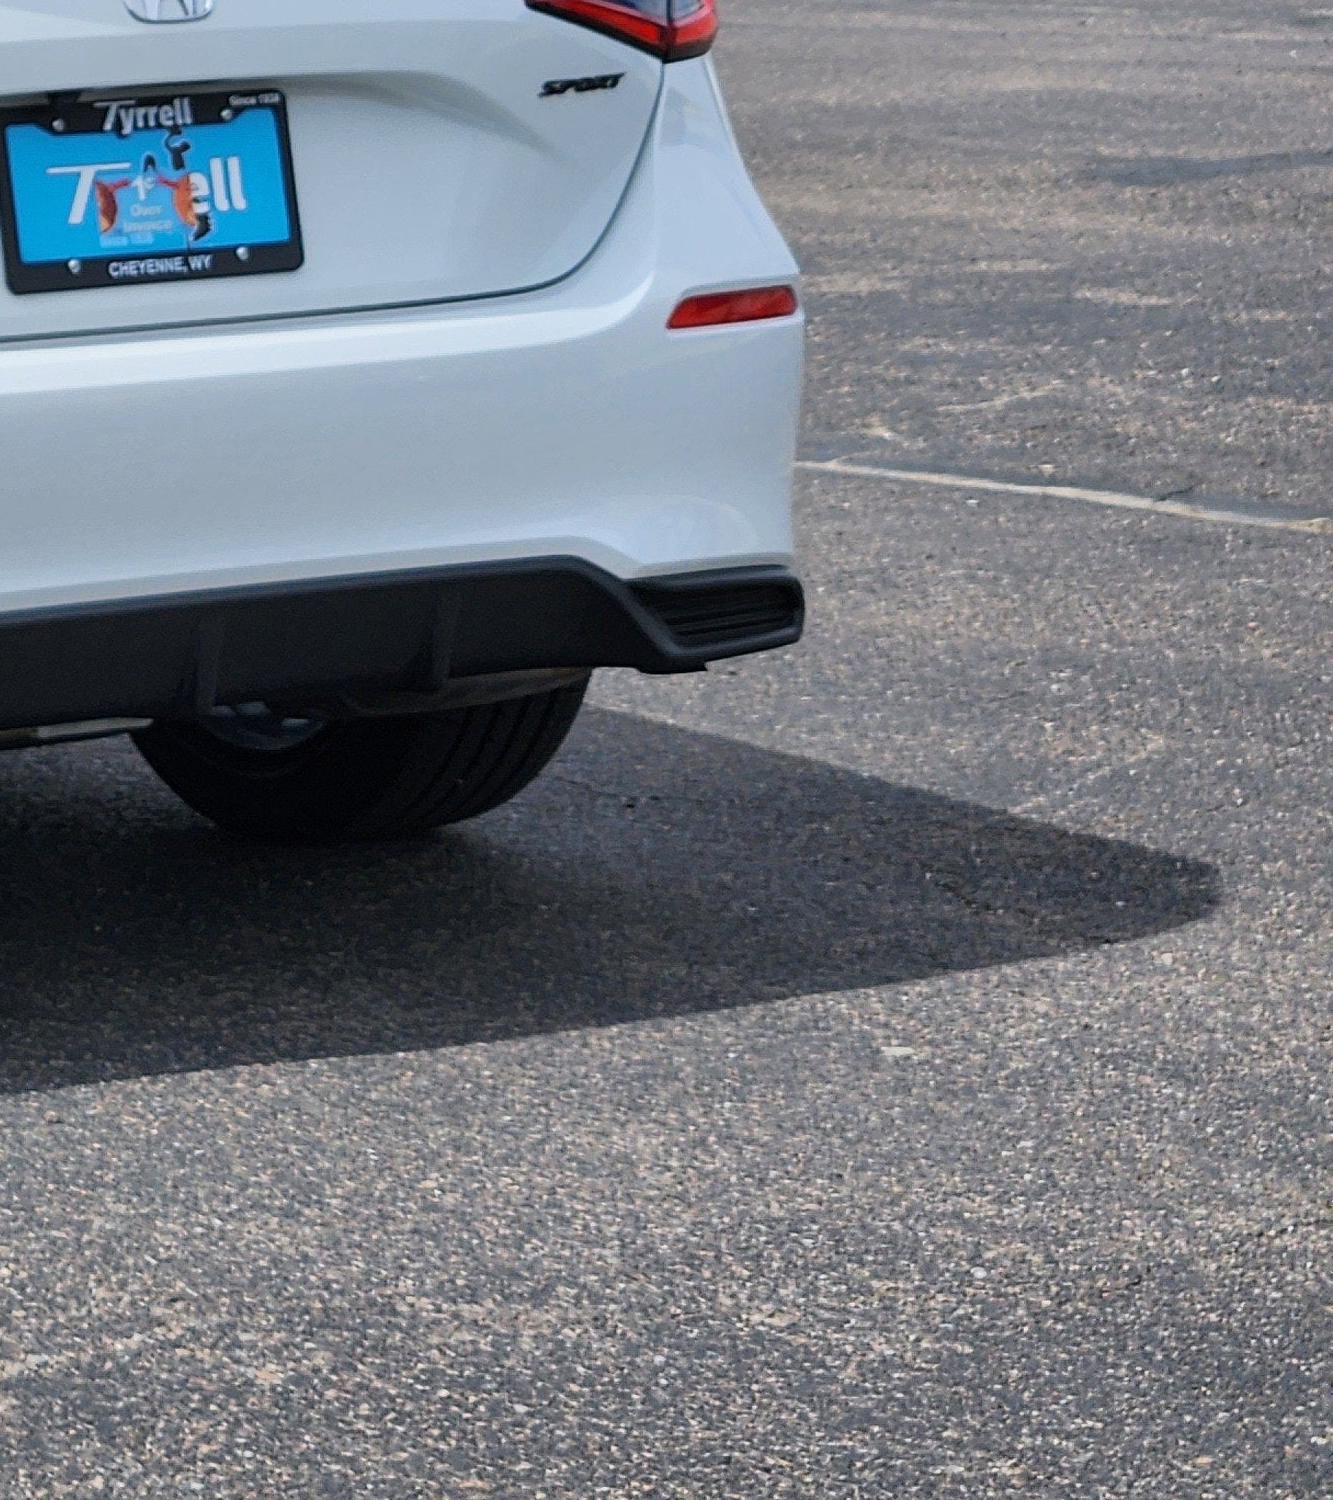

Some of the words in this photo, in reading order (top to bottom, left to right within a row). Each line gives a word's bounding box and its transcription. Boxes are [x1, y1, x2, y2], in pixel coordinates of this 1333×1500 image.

[537, 71, 626, 97] SPORT
[94, 97, 193, 135] Tyrrell
[45, 156, 247, 225] Tell
[108, 256, 188, 279] CHEYENNE,
[188, 254, 212, 271] WY
